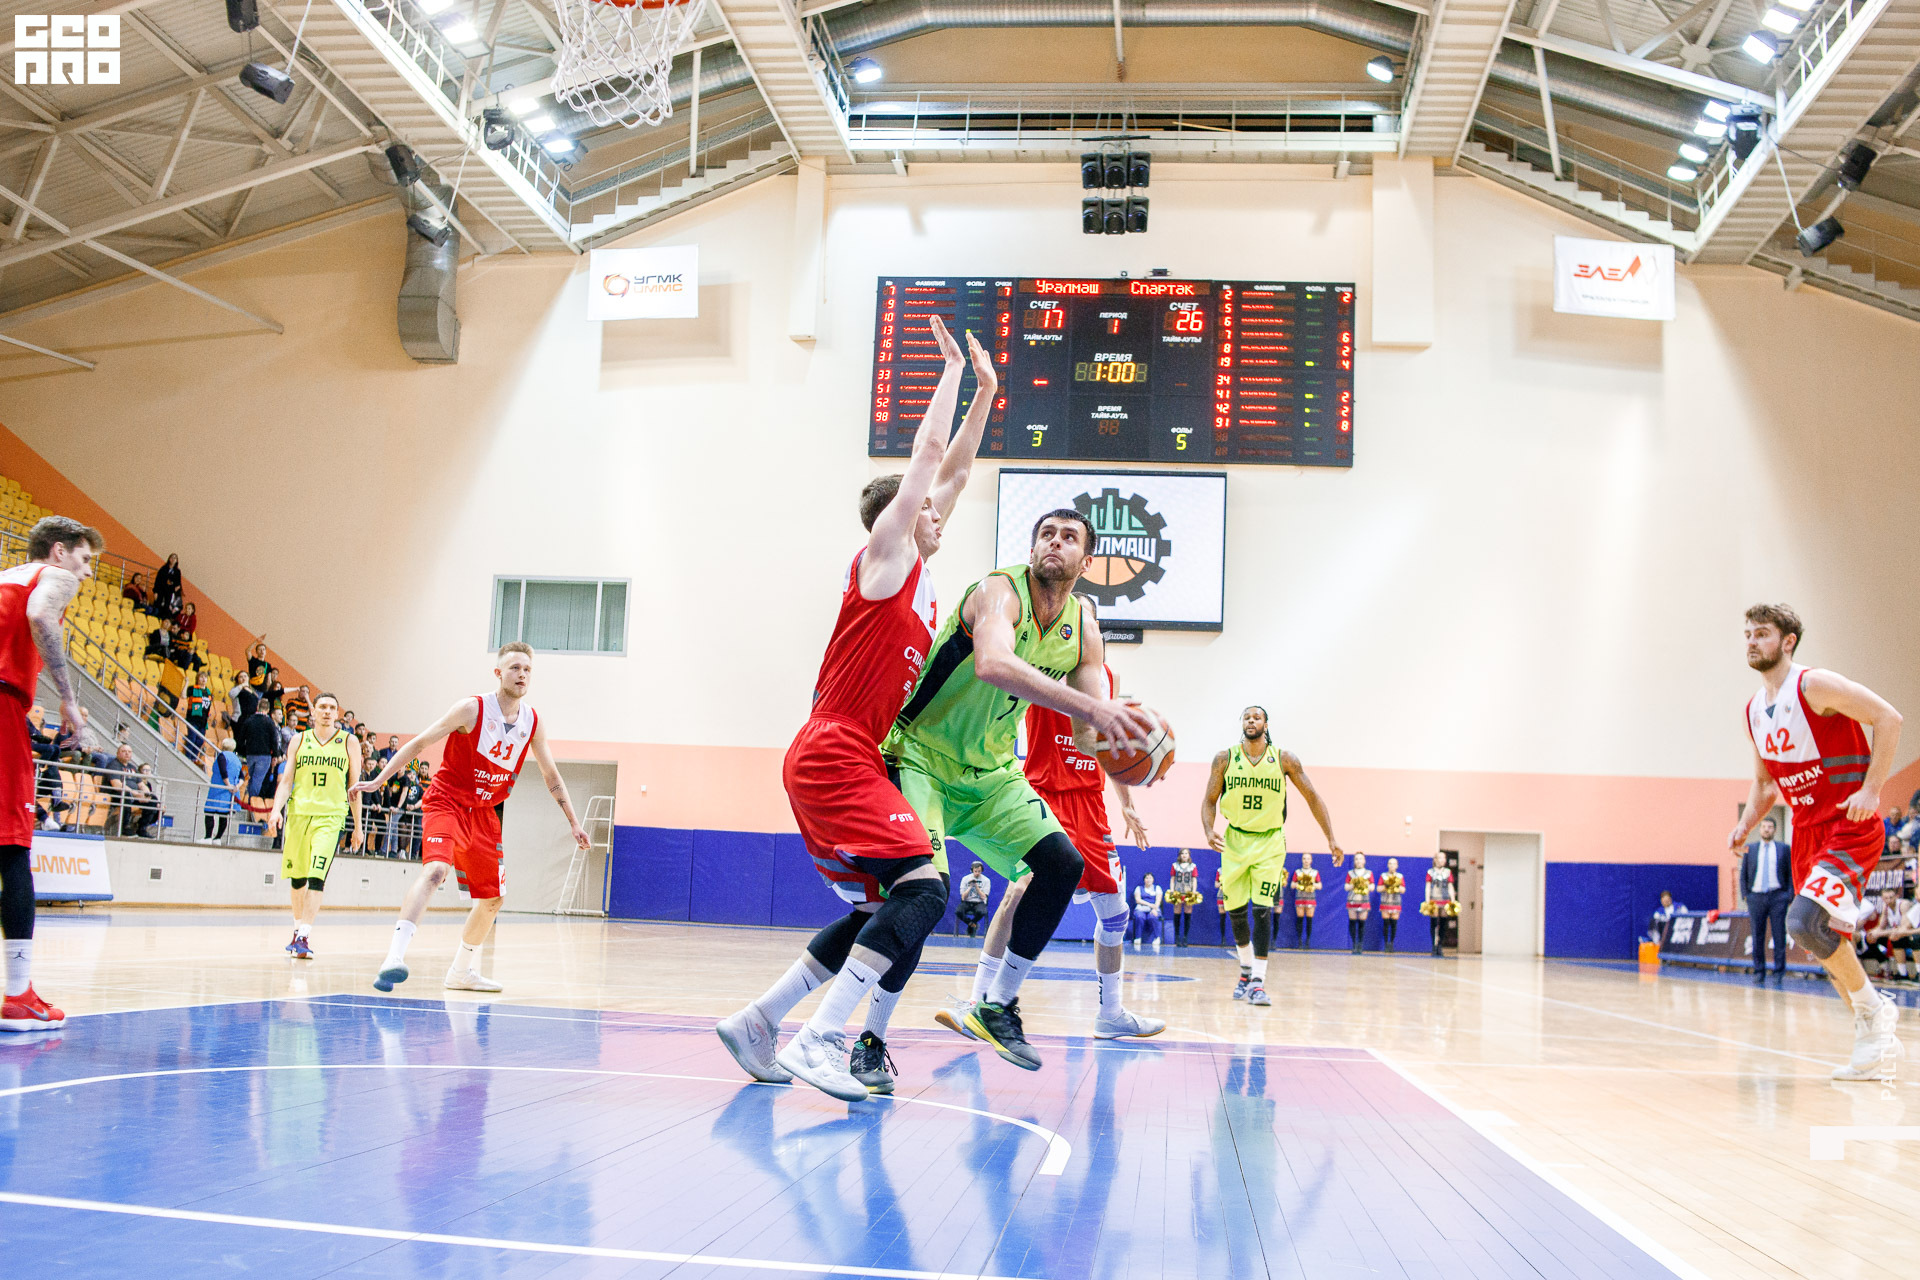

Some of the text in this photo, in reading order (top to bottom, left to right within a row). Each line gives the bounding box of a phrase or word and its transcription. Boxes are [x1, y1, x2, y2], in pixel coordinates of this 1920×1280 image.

[634, 274, 683, 284] УГМК
[634, 284, 682, 293] UMMC
[889, 286, 896, 295] 7
[1004, 287, 1012, 296] 7
[1036, 280, 1100, 294] Уралмаш
[1131, 281, 1195, 295] Спартак
[1224, 290, 1232, 300] 2
[1343, 293, 1351, 303] 2
[888, 299, 895, 309] 9
[1029, 301, 1059, 309] СЧЕТ
[1169, 302, 1199, 311] СЧЕТ
[1224, 303, 1232, 313] 5
[884, 312, 894, 322] 10
[1001, 313, 1009, 323] 2
[1044, 310, 1063, 328] 17
[1176, 311, 1204, 331] 26
[1224, 317, 1231, 326] 6
[883, 325, 893, 335] 13
[1113, 319, 1119, 334] 1
[1001, 327, 1009, 337] 3
[1023, 333, 1062, 341] ТАЙМ-АУТЫ
[1225, 330, 1231, 340] 7
[1162, 335, 1202, 343] ТАЙМ-АУТЫ
[1342, 332, 1350, 343] 6
[882, 339, 892, 349] 16
[1224, 344, 1231, 353] 8
[1342, 346, 1350, 356] 2
[879, 352, 892, 361] 31
[1000, 353, 1008, 363] 3
[1094, 353, 1133, 362] ВРЕМЯ
[1220, 357, 1231, 367] 19
[1342, 360, 1350, 369] 4
[878, 370, 891, 380] 33
[1095, 362, 1136, 382] 1:00
[1217, 375, 1230, 385] 34
[877, 383, 890, 393] 51
[1216, 389, 1230, 399] 41
[1342, 392, 1350, 402] 2
[876, 397, 889, 407] 52
[998, 399, 1006, 409] 2
[1216, 403, 1229, 413] 42
[1341, 407, 1349, 417] 2
[875, 411, 889, 422] 98
[1091, 412, 1128, 420] ТАЙМ-АУТА
[1216, 417, 1229, 427] 91
[1341, 421, 1349, 431] 8
[1032, 431, 1043, 447] 3
[1176, 434, 1187, 450] 5
[996, 695, 1019, 720] 7
[1765, 728, 1795, 755] 42
[489, 741, 514, 761] 41
[1075, 760, 1095, 771] ВТБ
[312, 772, 327, 786] 13
[1228, 776, 1281, 793] УРАЛМАШ
[1243, 795, 1263, 810] 98
[1026, 799, 1047, 820] 7
[897, 813, 914, 822] ВТБ
[312, 855, 327, 870] 13
[1806, 876, 1845, 907] 42
